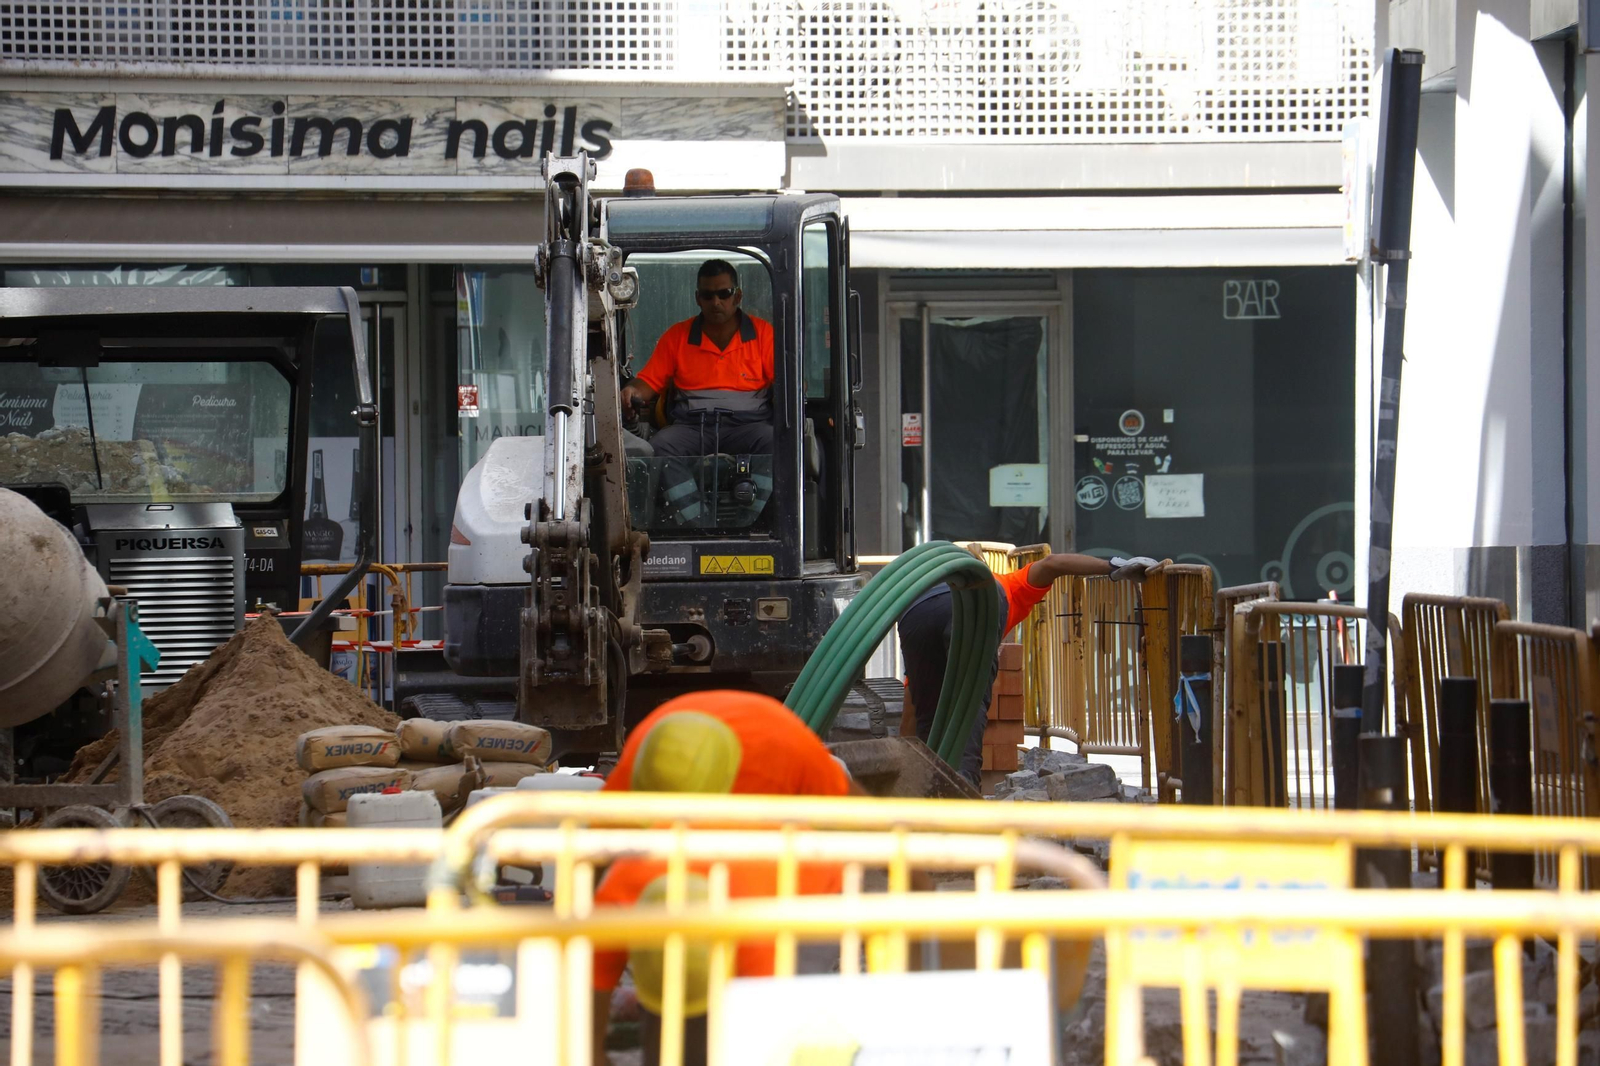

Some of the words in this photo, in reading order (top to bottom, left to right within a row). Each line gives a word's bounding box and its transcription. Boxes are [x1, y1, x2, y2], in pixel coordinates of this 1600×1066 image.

[49, 99, 413, 160] Monísima
[444, 103, 614, 159] nails
[1223, 279, 1281, 319] BAR
[192, 394, 237, 407] Pedicura
[0, 409, 34, 427] Nails
[115, 537, 225, 551] PIQUERSA
[324, 742, 374, 757] CEMEX
[476, 737, 525, 750] CEMEX
